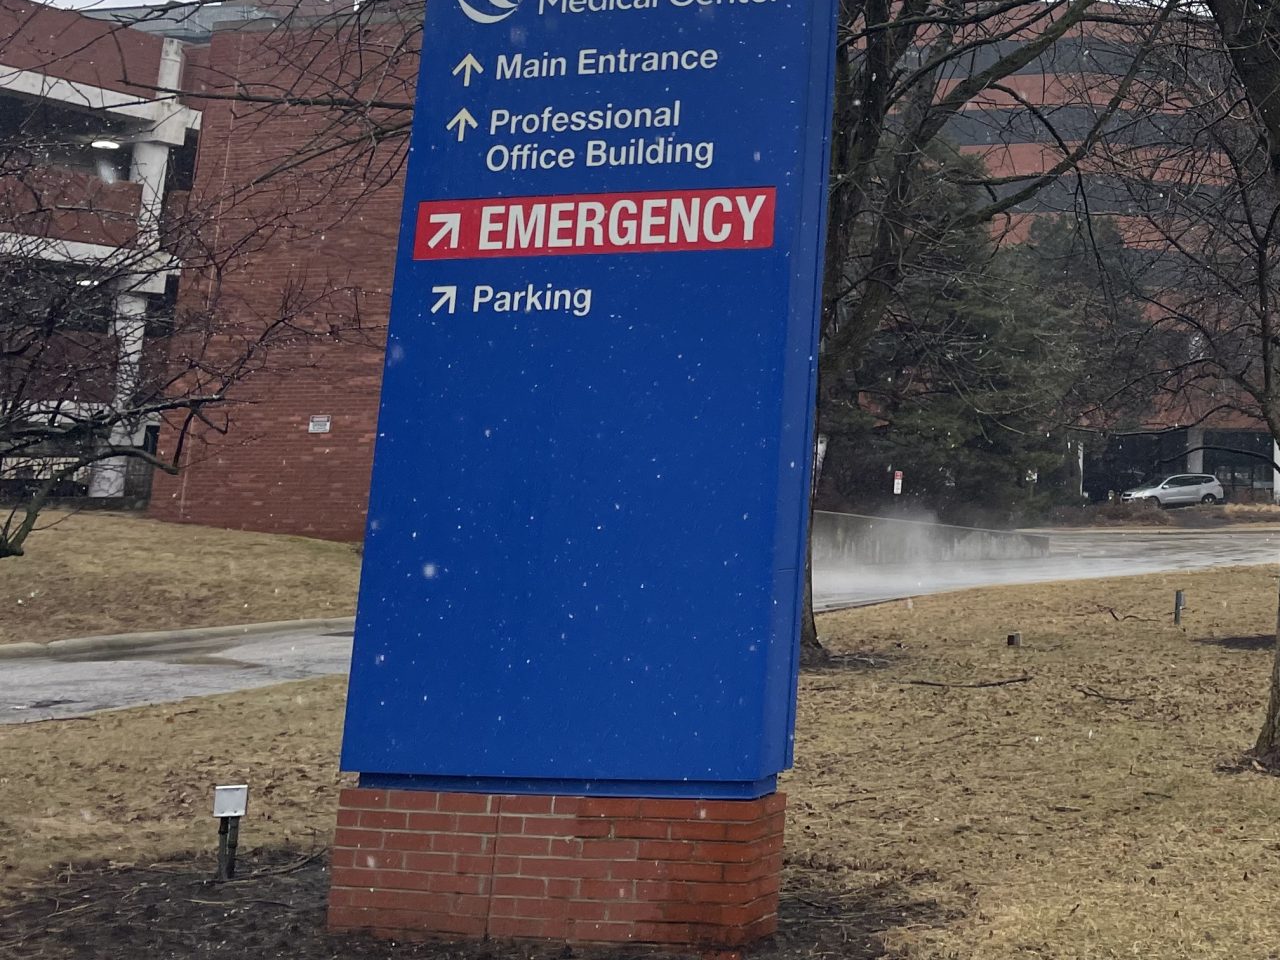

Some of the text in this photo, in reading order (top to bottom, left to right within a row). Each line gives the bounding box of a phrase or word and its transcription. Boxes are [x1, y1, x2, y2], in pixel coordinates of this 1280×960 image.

[495, 48, 718, 80] Main Entrance
[489, 100, 681, 135] Professional
[486, 137, 714, 172] Office Building
[478, 195, 766, 251] EMERGENCY
[473, 283, 592, 316] Parking
